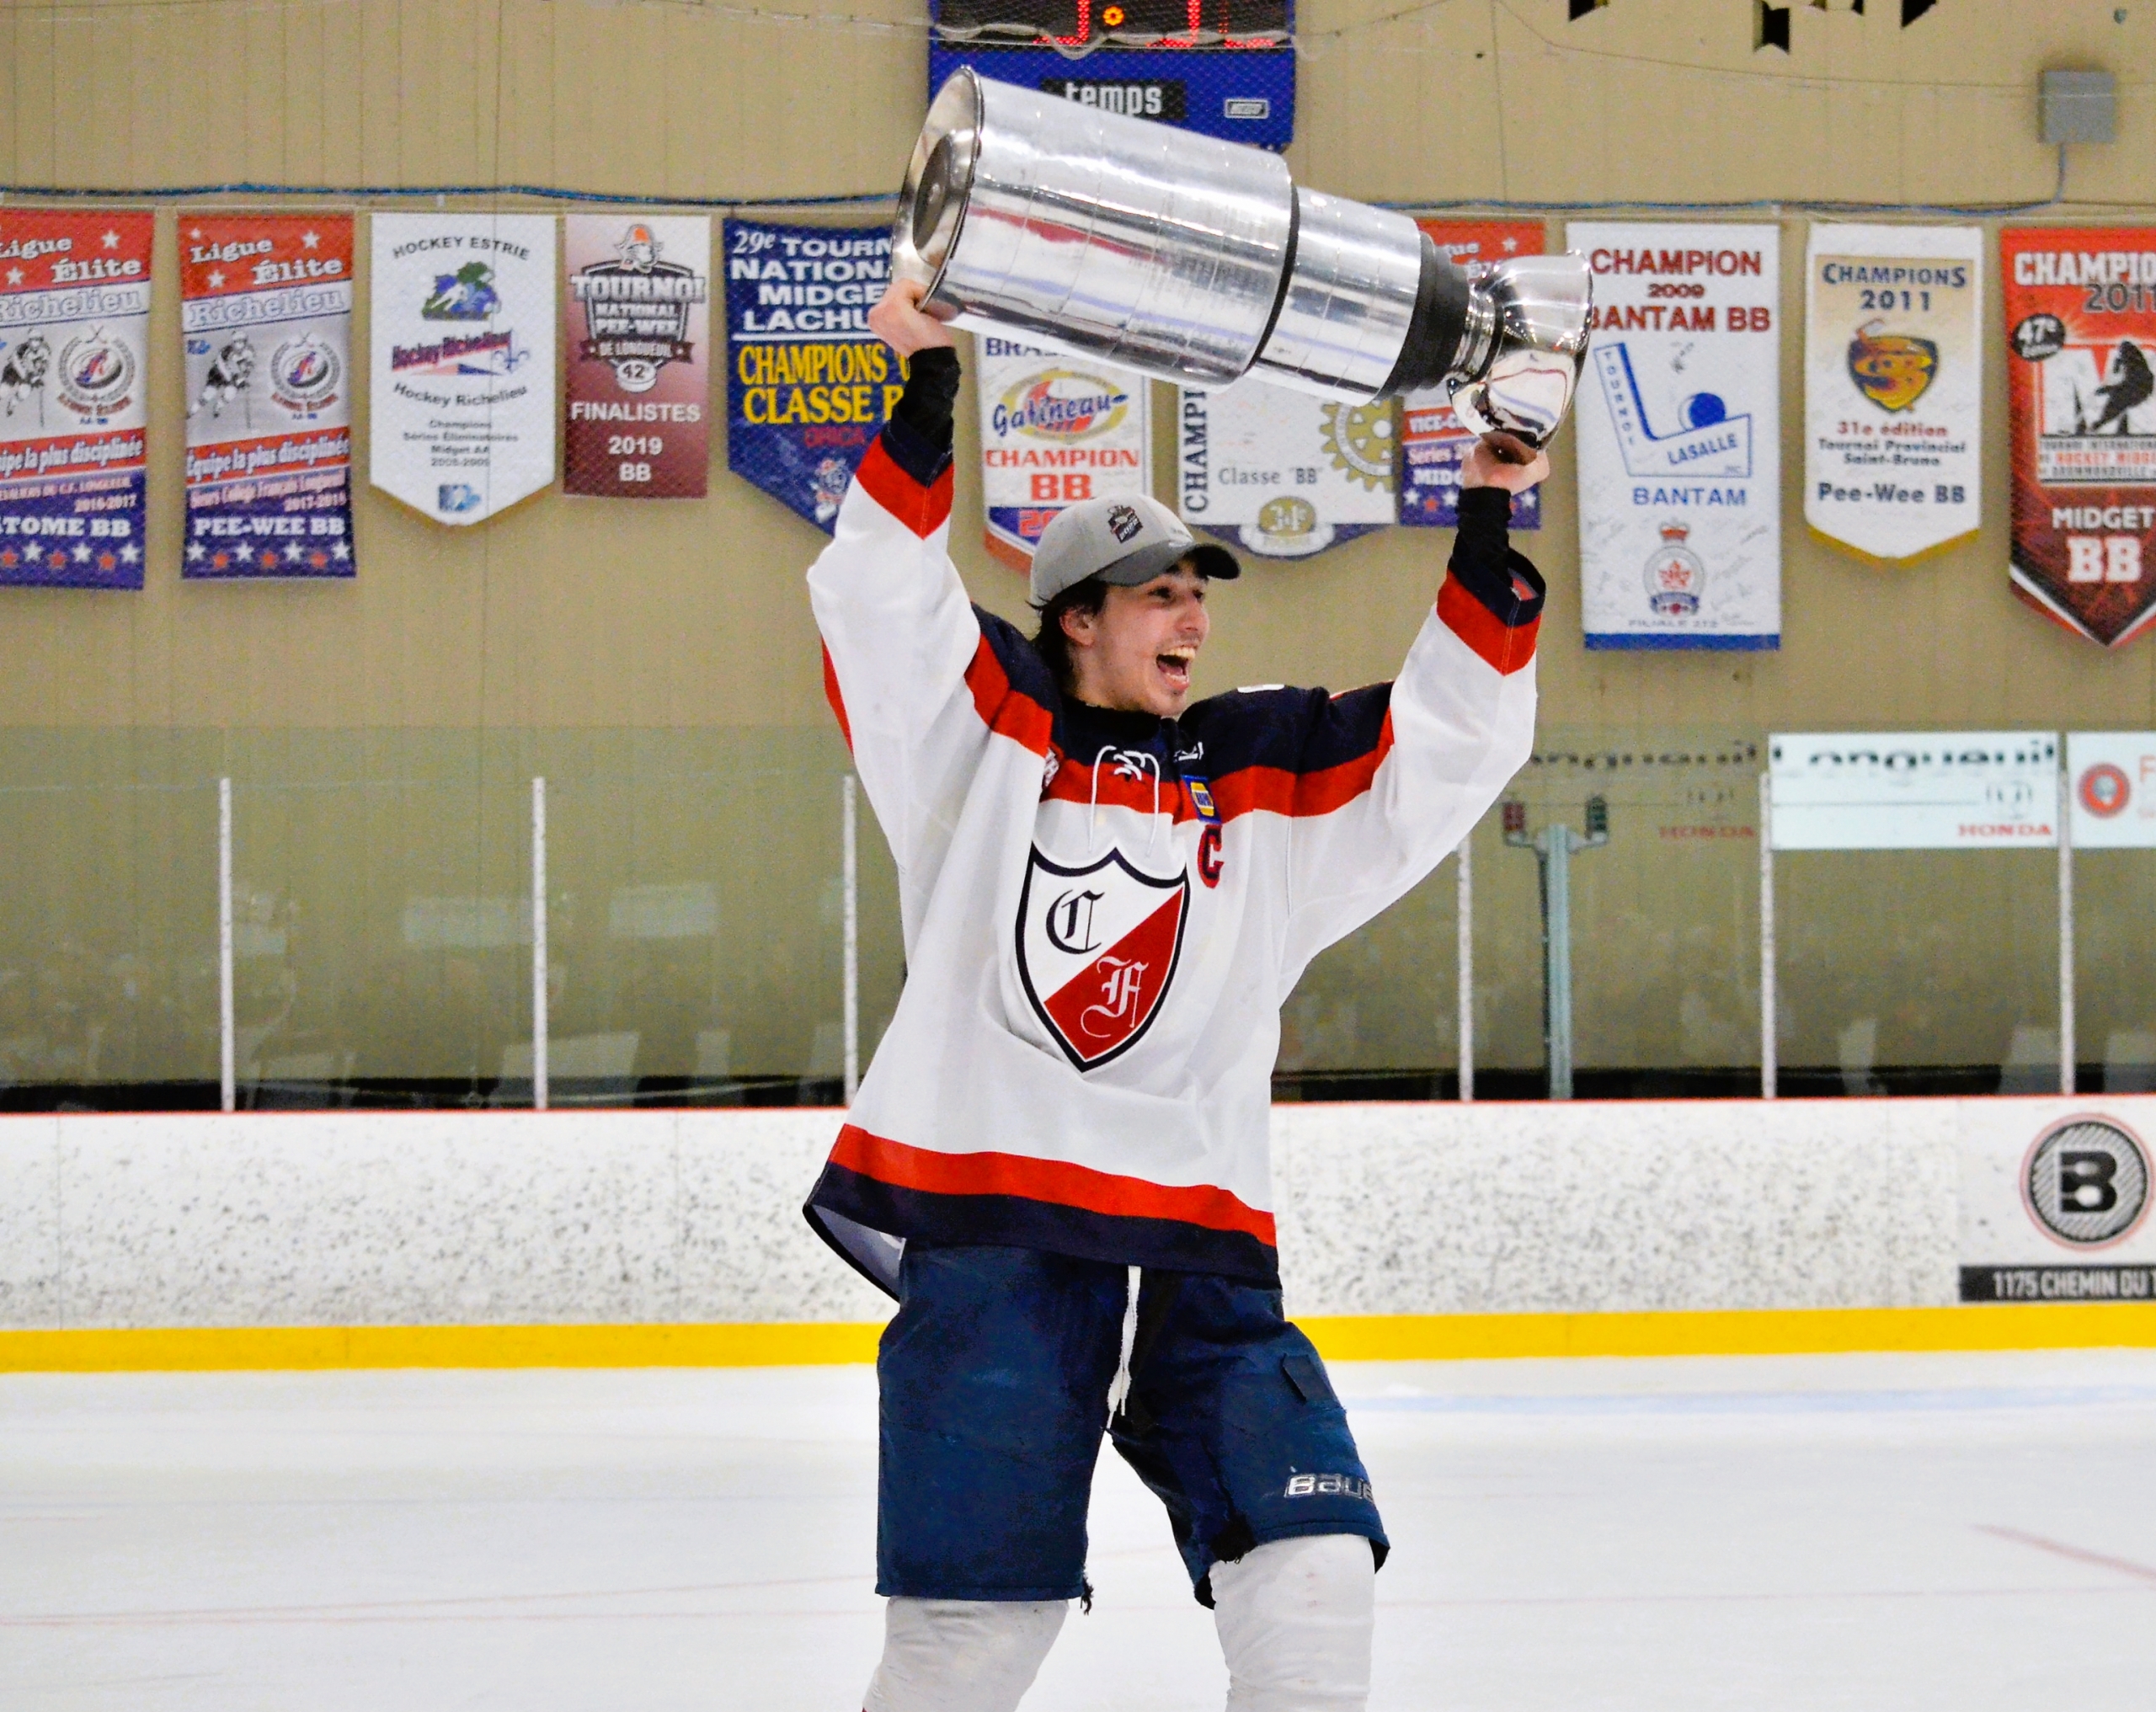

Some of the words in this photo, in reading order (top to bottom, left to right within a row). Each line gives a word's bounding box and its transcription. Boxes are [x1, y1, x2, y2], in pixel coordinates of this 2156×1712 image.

[1065, 82, 1162, 116] temps
[190, 237, 272, 264] Ligue
[393, 237, 463, 259] HOCKEY
[470, 237, 530, 260] ESTRIE
[733, 230, 776, 254] 29e
[51, 258, 142, 283] Élite
[252, 257, 343, 285] Élite
[731, 259, 891, 281] NATION
[1590, 248, 1762, 276] CHAMPION
[1823, 264, 1966, 288] CHAMPIONS
[570, 275, 706, 302] TOURNOI
[1647, 283, 1705, 298] 2009
[1861, 290, 1929, 311] 2011
[190, 289, 344, 327] Richelieu
[595, 303, 679, 317] NATIONAL
[1727, 307, 1770, 332] BB
[595, 318, 679, 335] PEE-WEE
[739, 344, 888, 385] CHAMPIONS
[393, 382, 451, 408] Hockey
[456, 386, 527, 406] Richelieu
[743, 385, 874, 424] CLASSE
[571, 401, 701, 422] FINALISTES
[993, 393, 1120, 437] Gatineau
[1838, 422, 1872, 435] 31e
[608, 435, 663, 455] 2019
[1668, 433, 1738, 465] LASALLE
[38, 443, 69, 474] plus
[985, 450, 1139, 467] CHAMPION
[619, 461, 651, 482] BB
[1219, 467, 1281, 484] Classe
[1031, 474, 1091, 500] BB
[1633, 488, 1746, 505] BANTAM
[1818, 483, 1924, 502] Pee-Wee
[1935, 485, 1965, 503] BB
[0, 516, 84, 536] TOME
[91, 519, 131, 536] BB
[194, 517, 306, 536] PEE-WEE
[310, 517, 345, 536] BB
[2052, 508, 2154, 529] MIDGET
[2067, 536, 2142, 583] BB
[1958, 824, 2052, 836] HONDA
[1197, 824, 1224, 888] C
[1993, 1271, 2038, 1299] 1175
[2041, 1271, 2117, 1297] CHEMIN
[2121, 1271, 2147, 1297] DU
